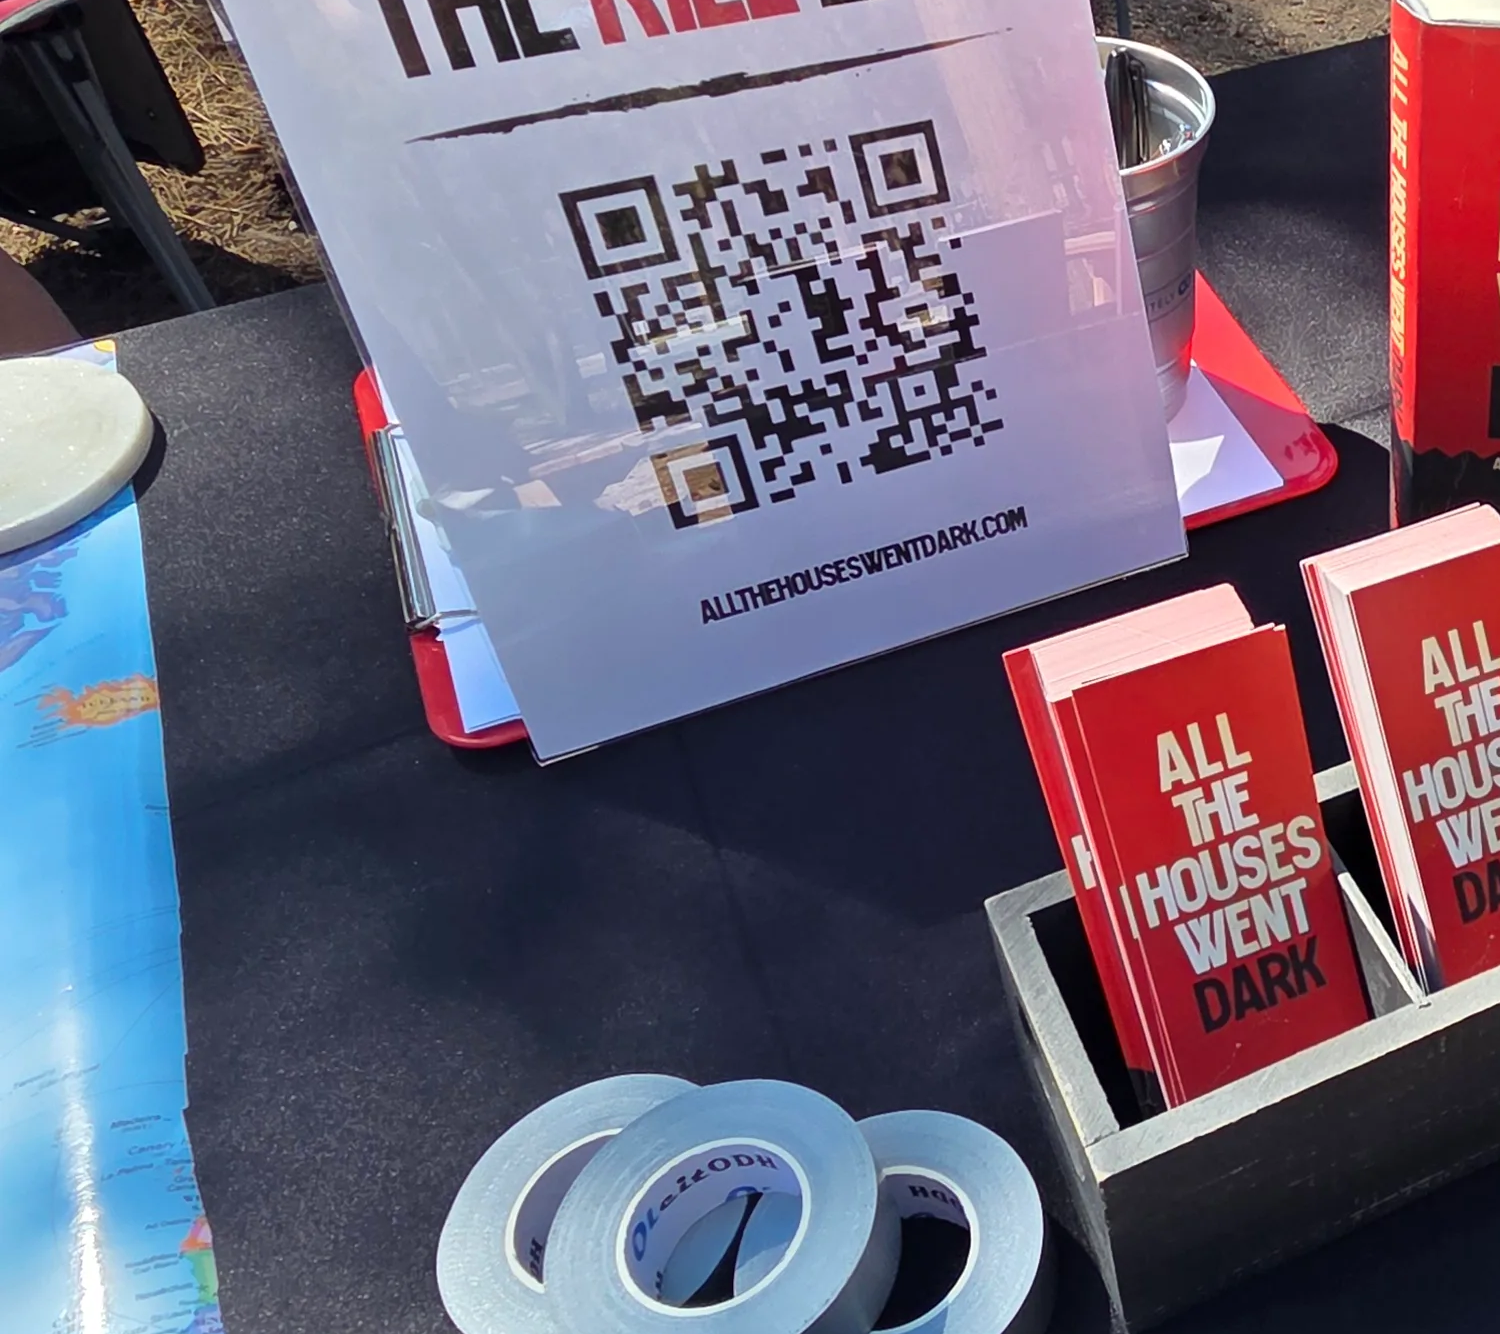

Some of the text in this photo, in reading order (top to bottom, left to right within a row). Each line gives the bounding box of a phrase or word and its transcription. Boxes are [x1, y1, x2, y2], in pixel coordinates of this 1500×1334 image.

[1391, 40, 1409, 106] ALL
[698, 505, 1028, 625] ALLTHEHOUSESWENTDARK.COM
[1157, 711, 1252, 793] ALL
[1172, 771, 1260, 848] THE
[1136, 815, 1322, 930] HOUSES
[1175, 878, 1312, 976] WENT
[1194, 939, 1328, 1034] DARK
